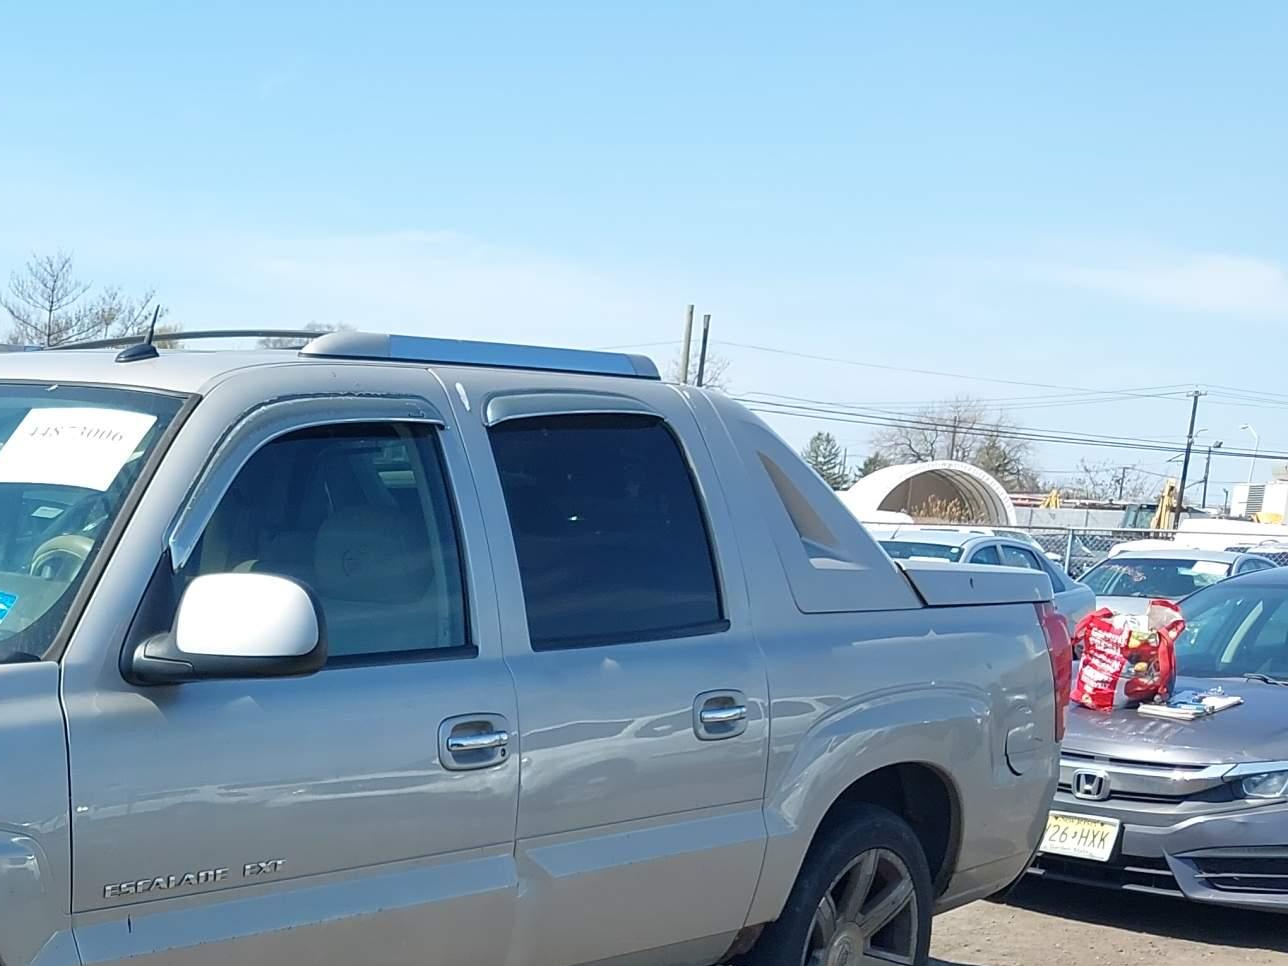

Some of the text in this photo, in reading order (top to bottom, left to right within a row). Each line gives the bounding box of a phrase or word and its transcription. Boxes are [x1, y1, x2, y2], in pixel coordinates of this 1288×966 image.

[27, 425, 126, 442] 4483006
[1076, 828, 1111, 850] HXK
[103, 857, 288, 899] ESCALADE EXT
